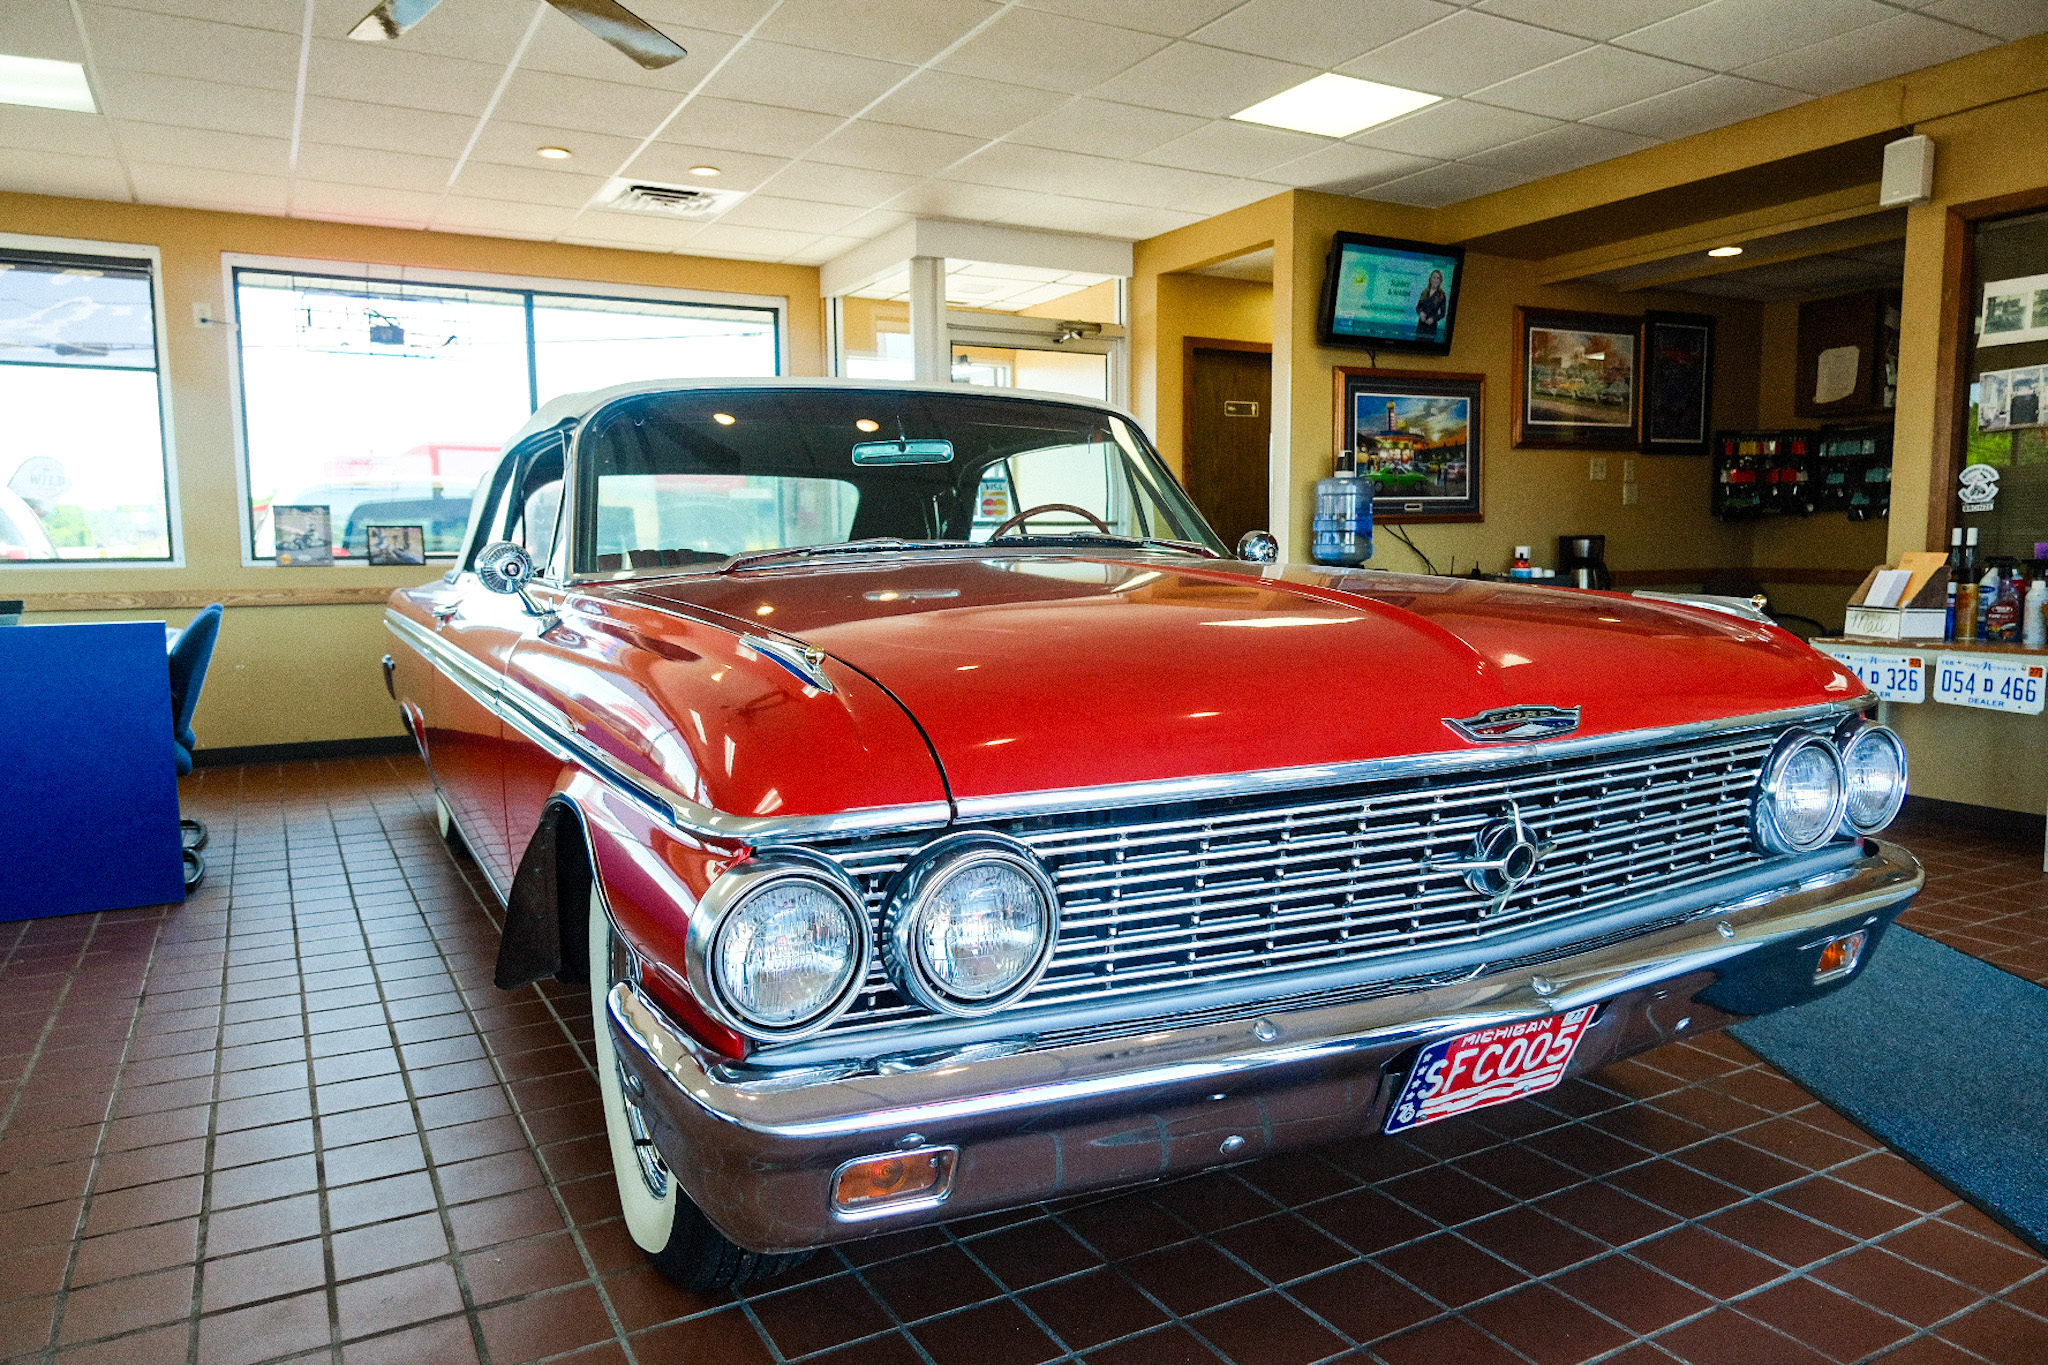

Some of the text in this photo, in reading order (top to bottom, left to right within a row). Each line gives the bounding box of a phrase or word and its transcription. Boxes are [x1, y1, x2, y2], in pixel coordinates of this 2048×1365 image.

[1871, 670, 1880, 684] D
[1886, 668, 1918, 691] 326
[1941, 669, 2036, 703] 054 D 466
[1967, 697, 2005, 707] DEALER
[1490, 710, 1552, 723] FORD
[1460, 1018, 1553, 1047] MICHIGAN
